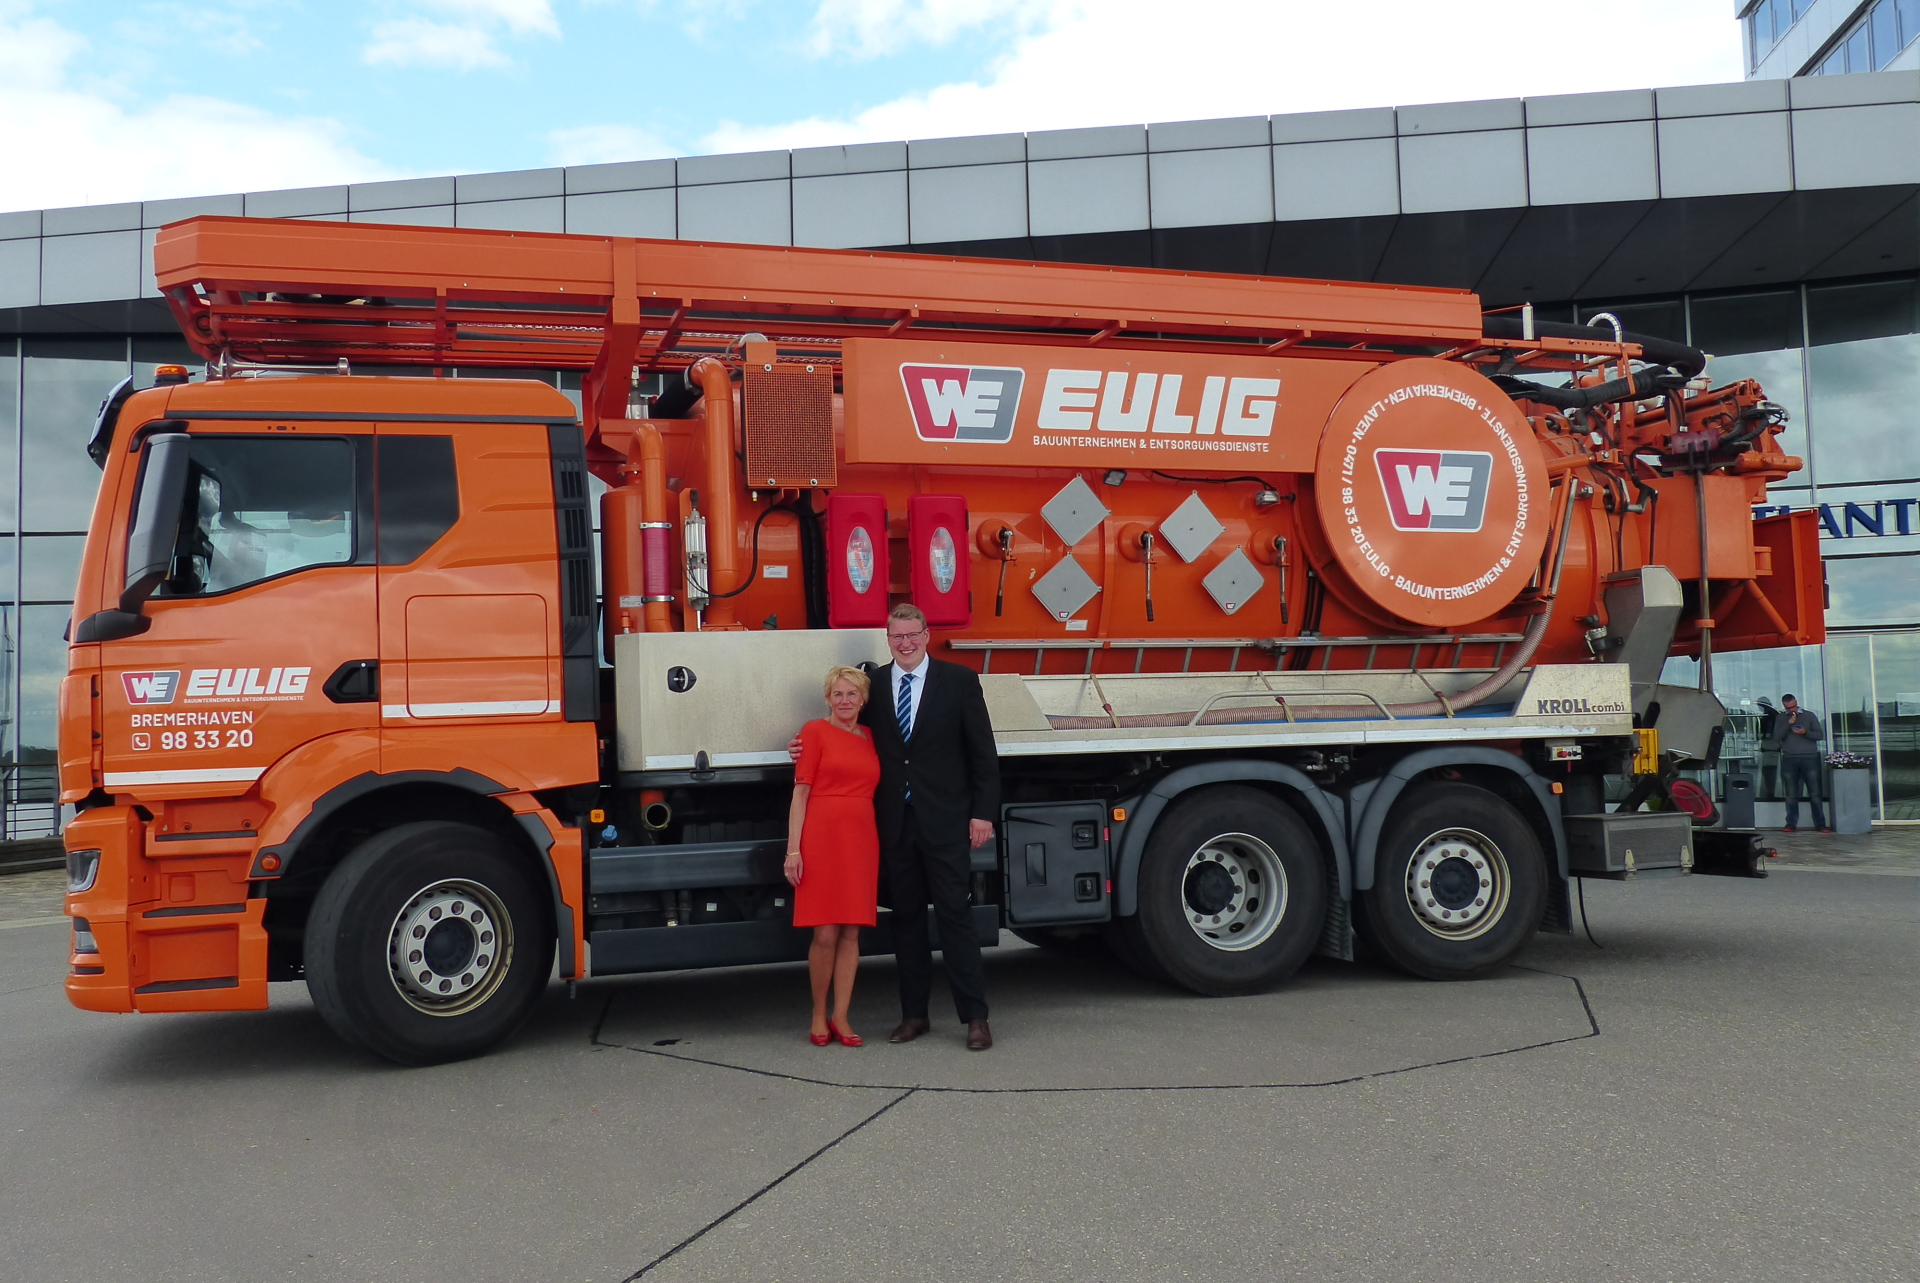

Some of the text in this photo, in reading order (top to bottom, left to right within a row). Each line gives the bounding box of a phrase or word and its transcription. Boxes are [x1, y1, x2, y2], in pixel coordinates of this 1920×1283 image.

[921, 378, 1004, 428] WE
[1037, 368, 1281, 437] EULIG
[1389, 384, 1477, 410] BREMERHAVEN
[1352, 401, 1386, 440] LAVEN
[1033, 435, 1270, 453] BAUUNTERNEHMEN & ENTSORGUNGSDIENSTE
[1341, 445, 1357, 476] 0471
[1342, 487, 1354, 504] 98
[1395, 464, 1474, 516] WE
[1359, 407, 1530, 600] EULIG BAUUNTERNEHMEN & ENTSORGUNGSDIENSTE
[1344, 506, 1359, 525] 33
[1350, 525, 1366, 544] 20
[131, 677, 171, 698] WE
[186, 667, 311, 696] EULIG
[1537, 699, 1591, 714] KROLL
[131, 711, 253, 727] BREMERHAVEN
[161, 729, 253, 750] 98 33 20
